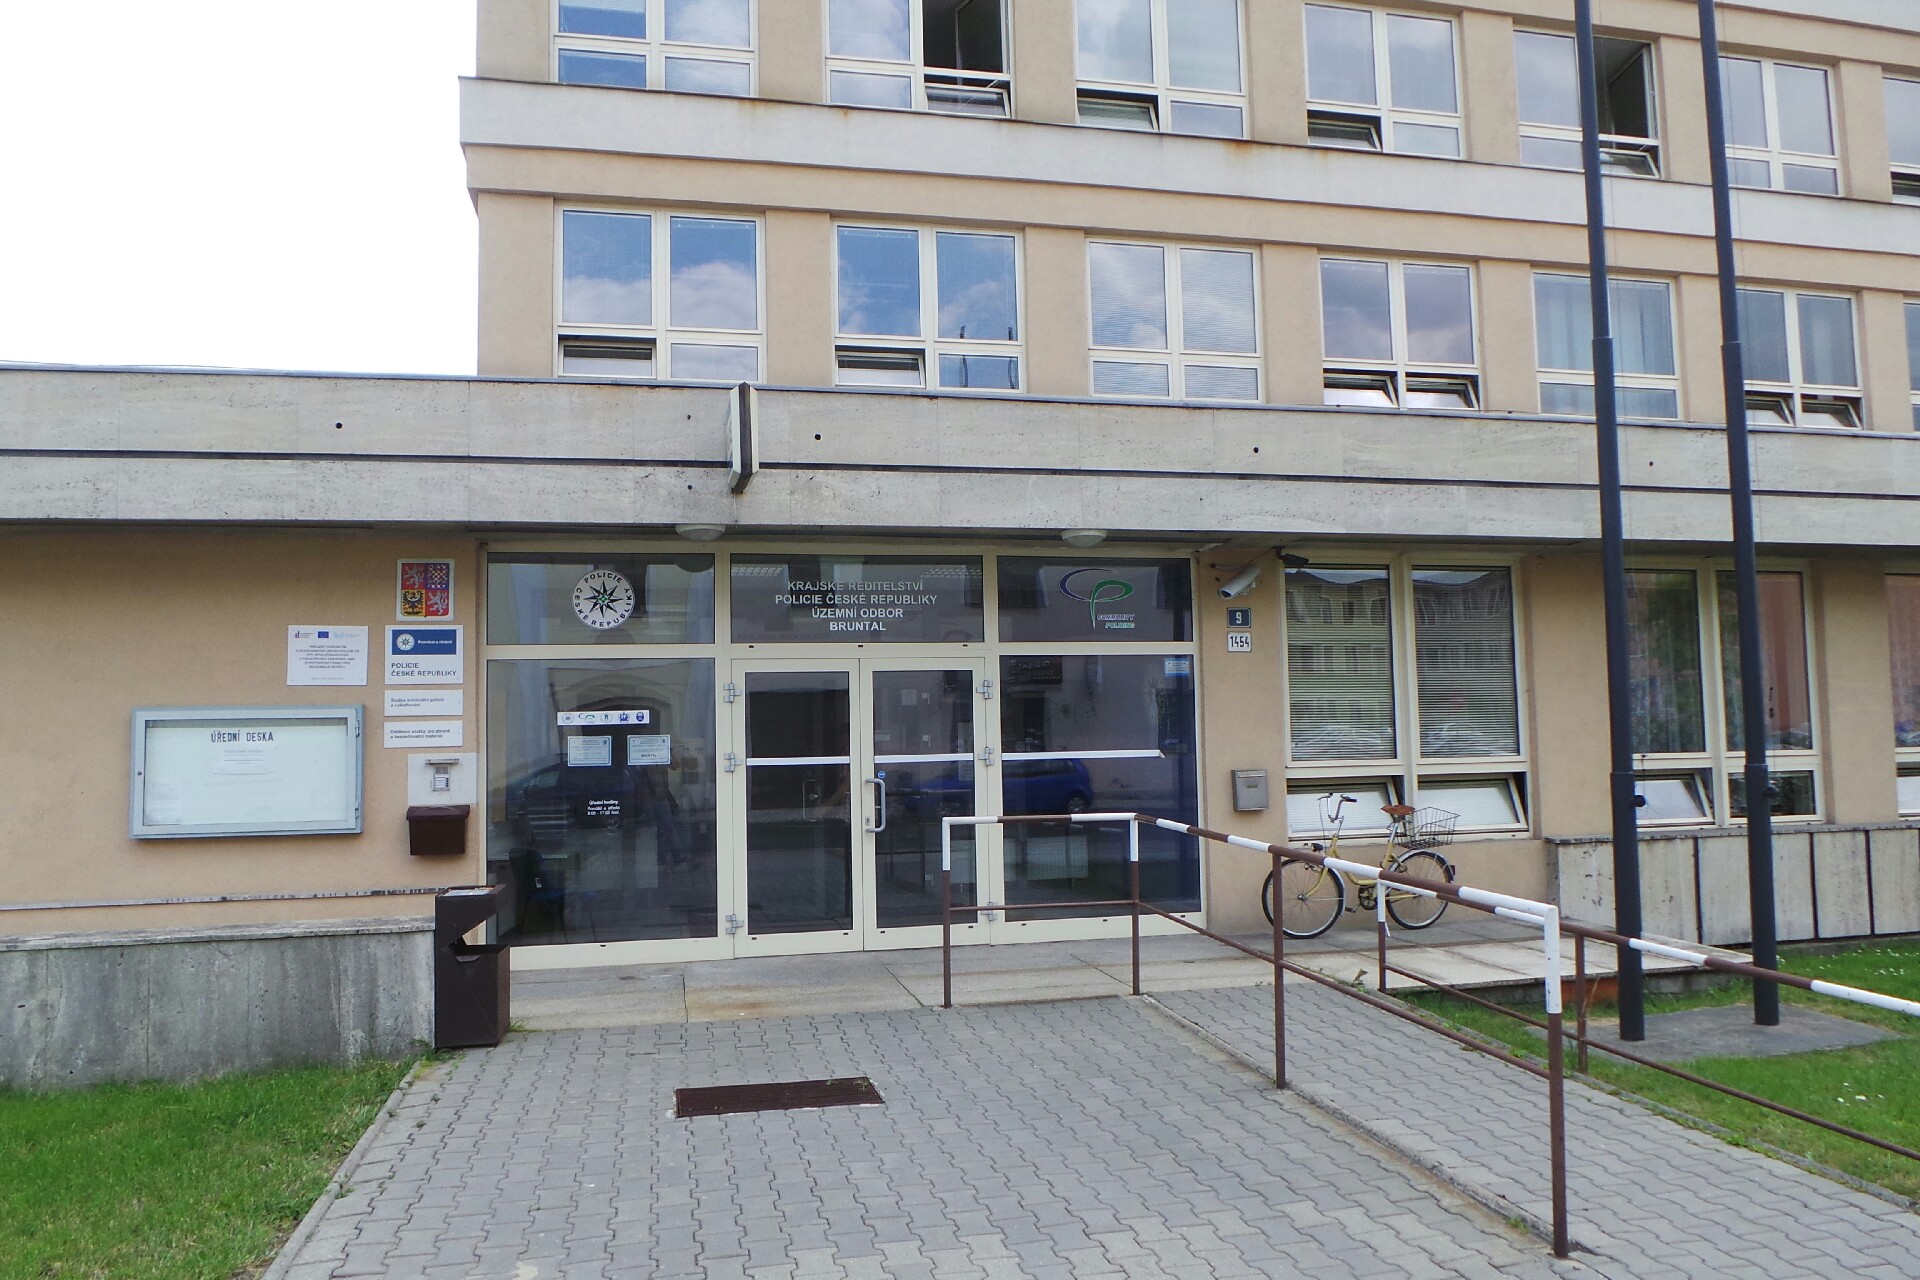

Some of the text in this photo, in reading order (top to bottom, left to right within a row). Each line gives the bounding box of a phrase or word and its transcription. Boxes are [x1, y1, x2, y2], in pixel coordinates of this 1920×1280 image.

[583, 572, 623, 584] POLICIE
[775, 592, 937, 605] POLICIE ČESKÉ REPUBLIKY
[590, 588, 633, 628] REPUBLIKY
[811, 606, 904, 618] ÚZEMNÍ ODBOR
[1235, 611, 1242, 624] 9
[1229, 635, 1250, 648] 1454
[246, 731, 274, 742] DESKA
